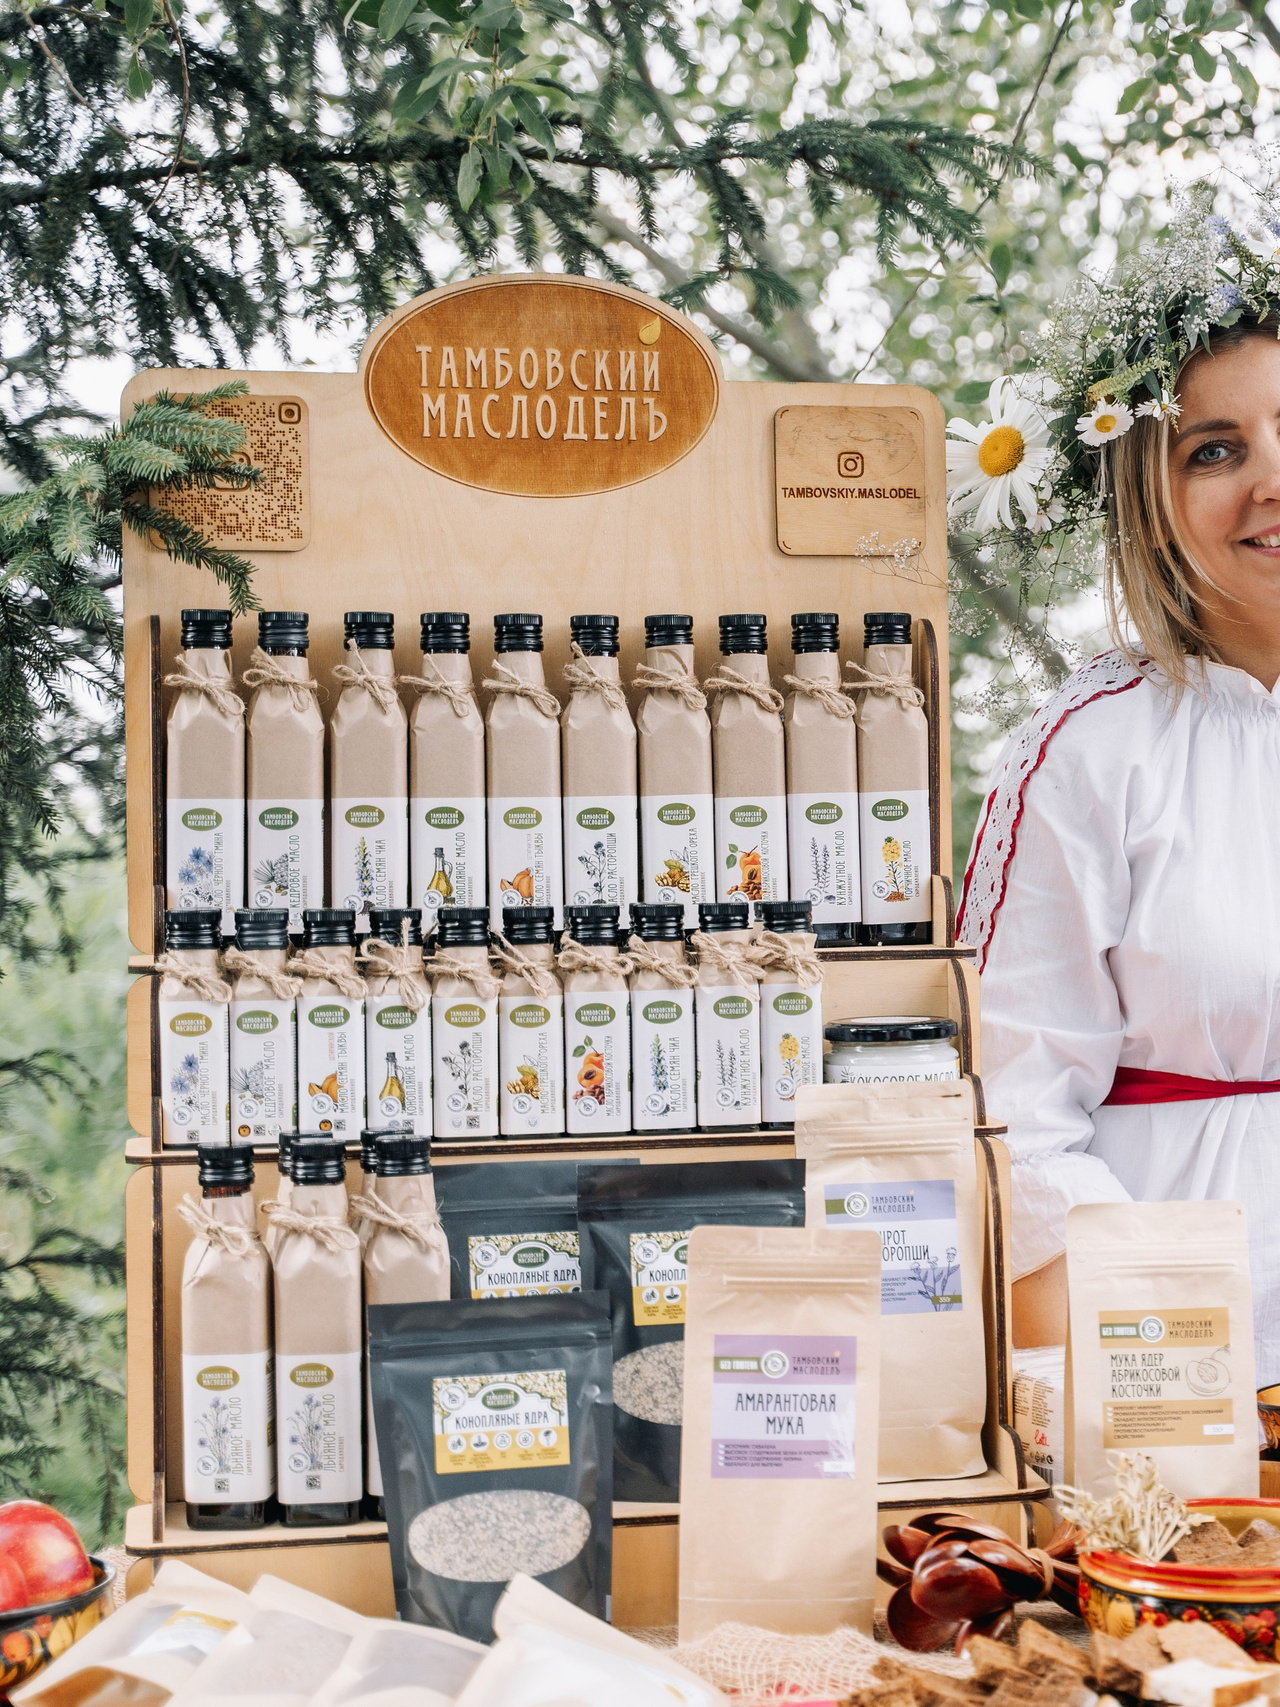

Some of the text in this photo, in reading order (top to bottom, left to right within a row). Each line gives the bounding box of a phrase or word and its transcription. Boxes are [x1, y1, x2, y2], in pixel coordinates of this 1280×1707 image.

[420, 394, 668, 443] МАСЛОДЕЛЪ
[781, 487, 921, 502] TAMBOVSKIY.MASLODEL
[214, 832, 223, 854] ТМИНА
[375, 840, 386, 854] ЧИА
[456, 832, 465, 857] МАСЛО
[534, 833, 543, 858] ТЫКВЫ
[288, 835, 300, 908] КЕДРОВОЕ МАСЛО
[375, 858, 386, 882] СЕМЯН
[534, 861, 544, 882] СЕМЯН
[607, 833, 618, 904] АСЛО РАСТОРОПШИ
[690, 828, 700, 904] МАСЛО ГРЕЦКОГО ОРЕХА
[835, 831, 846, 905] КУНЖУТНОЕ МАСЛО
[903, 841, 913, 897] ГОРЧИЧНОЕ МАСЛО
[199, 1041, 209, 1064] ТМИНА
[801, 1037, 810, 1085] ЧИЧНОЕ МАСЛО
[263, 1041, 276, 1118] КЕДРОВОЕ МАСЛО
[337, 1032, 349, 1113] МАСЛО СЕМЯН ТЫКВЫ
[404, 1034, 417, 1116] КОНОПЛЯНОЕ МАСЛО
[472, 1032, 483, 1112] МАСЛО РАСТОРОПШИ
[539, 1032, 549, 1114] МАСЛО ГРЕЦКОГО ОРЕХА
[604, 1036, 614, 1116] МАСЛО АБРИКОСОВОЙ КОСТОЧКИ
[669, 1037, 681, 1112] МАСЛО СЕМЯН ЧИА
[739, 1029, 751, 1106] КУНЖУТНОЕ МАСЛО
[199, 1101, 210, 1125] МАСЛО
[872, 1204, 916, 1214] МАСЛОДЕЛЪ
[882, 1246, 930, 1262] ОРОПШИ
[488, 1268, 577, 1286] КОНОПЛЯНЫЕ ЯДРА
[649, 1269, 686, 1282] КОНОПЛ
[1169, 1330, 1214, 1338] МАСЛОДЕЛЪ
[793, 1366, 840, 1375] МАСЛОДЕЛЪ
[1110, 1353, 1164, 1367] МУКА ЯДЕР
[1112, 1366, 1180, 1383] АБРИКОСОВОЙ
[735, 1393, 836, 1412] АМАРАНТОВАЯ
[1112, 1384, 1161, 1398] КОСТОЧКИ
[455, 1411, 549, 1430] КОНОПЛЯНЫЕ ЯДРА
[766, 1416, 804, 1434] МУКА
[229, 1397, 244, 1475] ЛЬНЯНОЕ МАСЛО
[322, 1394, 336, 1472] ЛЬНЯНОЕ МАСЛО
